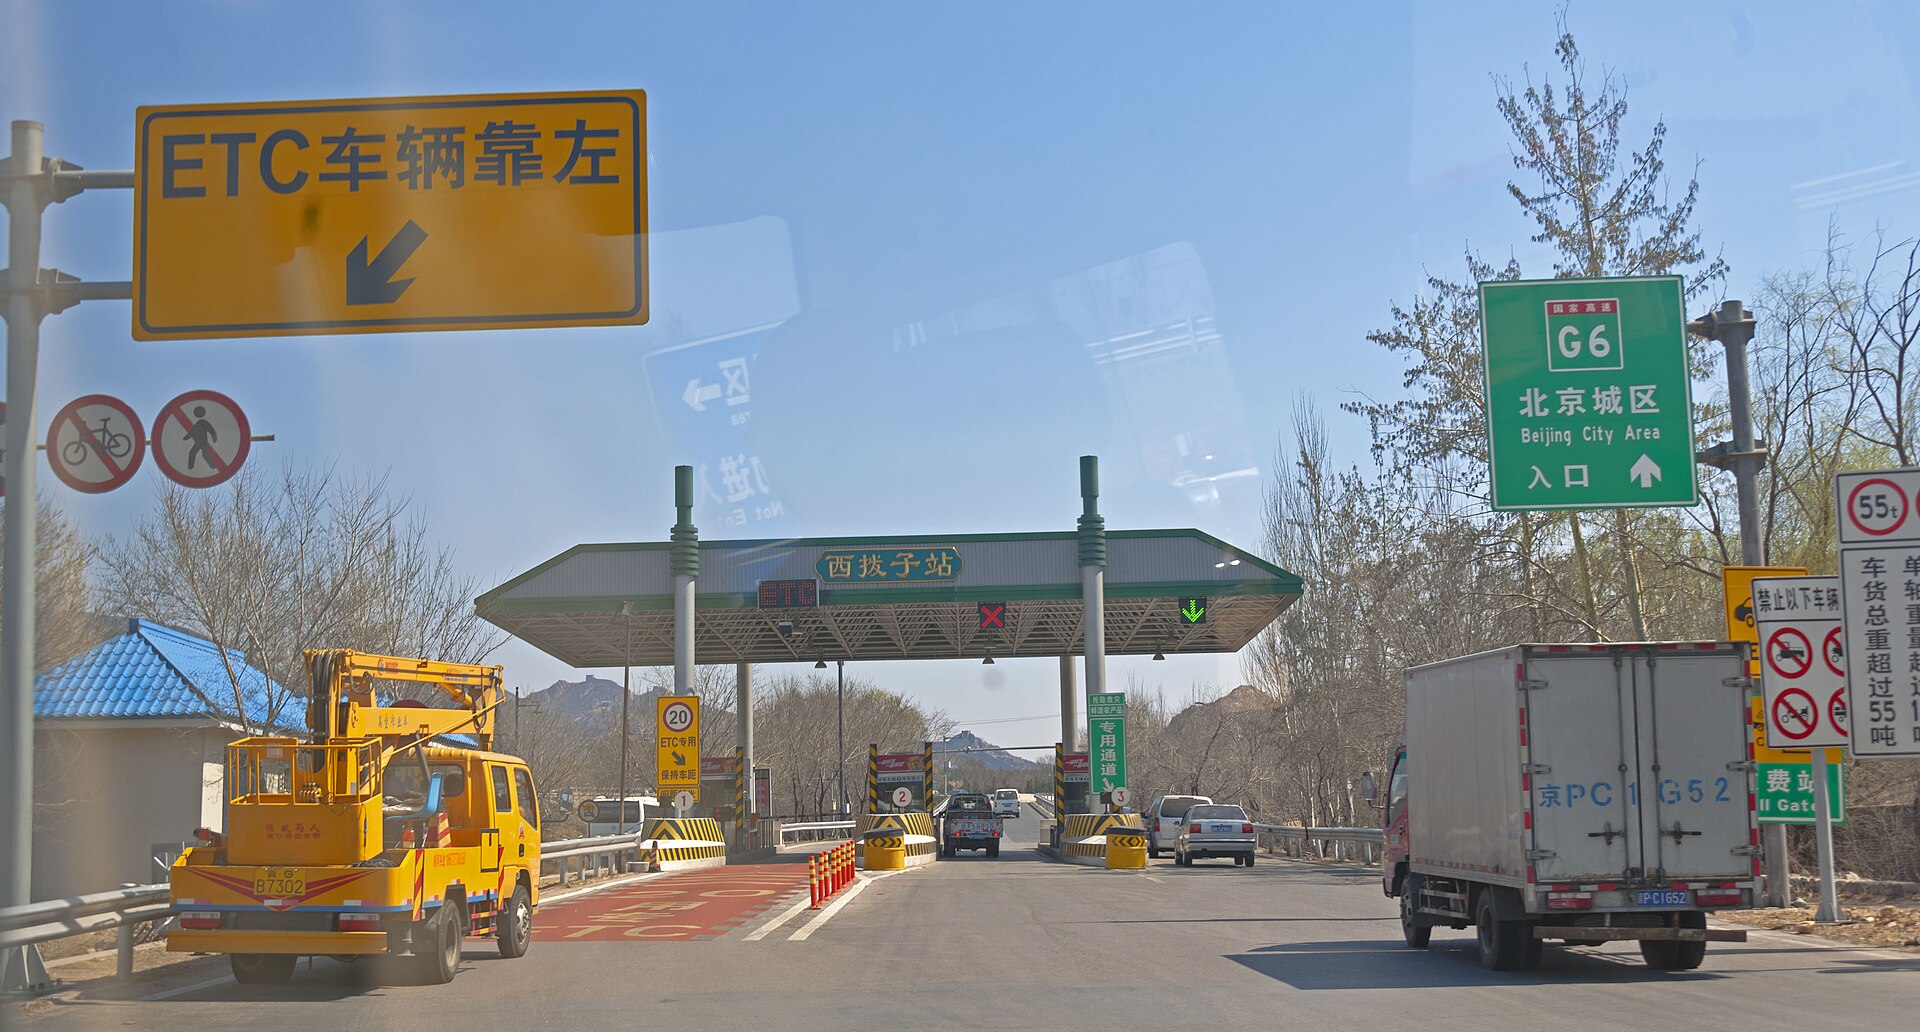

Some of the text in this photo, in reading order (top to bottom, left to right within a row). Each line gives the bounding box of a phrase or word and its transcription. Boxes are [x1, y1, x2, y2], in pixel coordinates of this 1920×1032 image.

[162, 119, 620, 199] ETC车辆靠左
[1553, 302, 1611, 314] 国家高速
[1557, 325, 1611, 358] G6
[1519, 384, 1660, 417] 北京城区
[1521, 424, 1661, 447] Beijing City Area
[1527, 464, 1590, 490] 入口
[1859, 494, 1898, 519] 55t
[825, 551, 953, 579] 西拨子站
[760, 582, 816, 606] ETC
[1757, 587, 1839, 612] 禁止以下车辆
[669, 710, 688, 724] 20
[660, 736, 697, 748] ETC专用
[1099, 721, 1118, 776] 专用通道
[661, 769, 697, 780] 保持车距
[680, 795, 686, 807] 1
[898, 791, 906, 803] 2
[1117, 791, 1125, 803] 3
[256, 879, 303, 894] B7302
